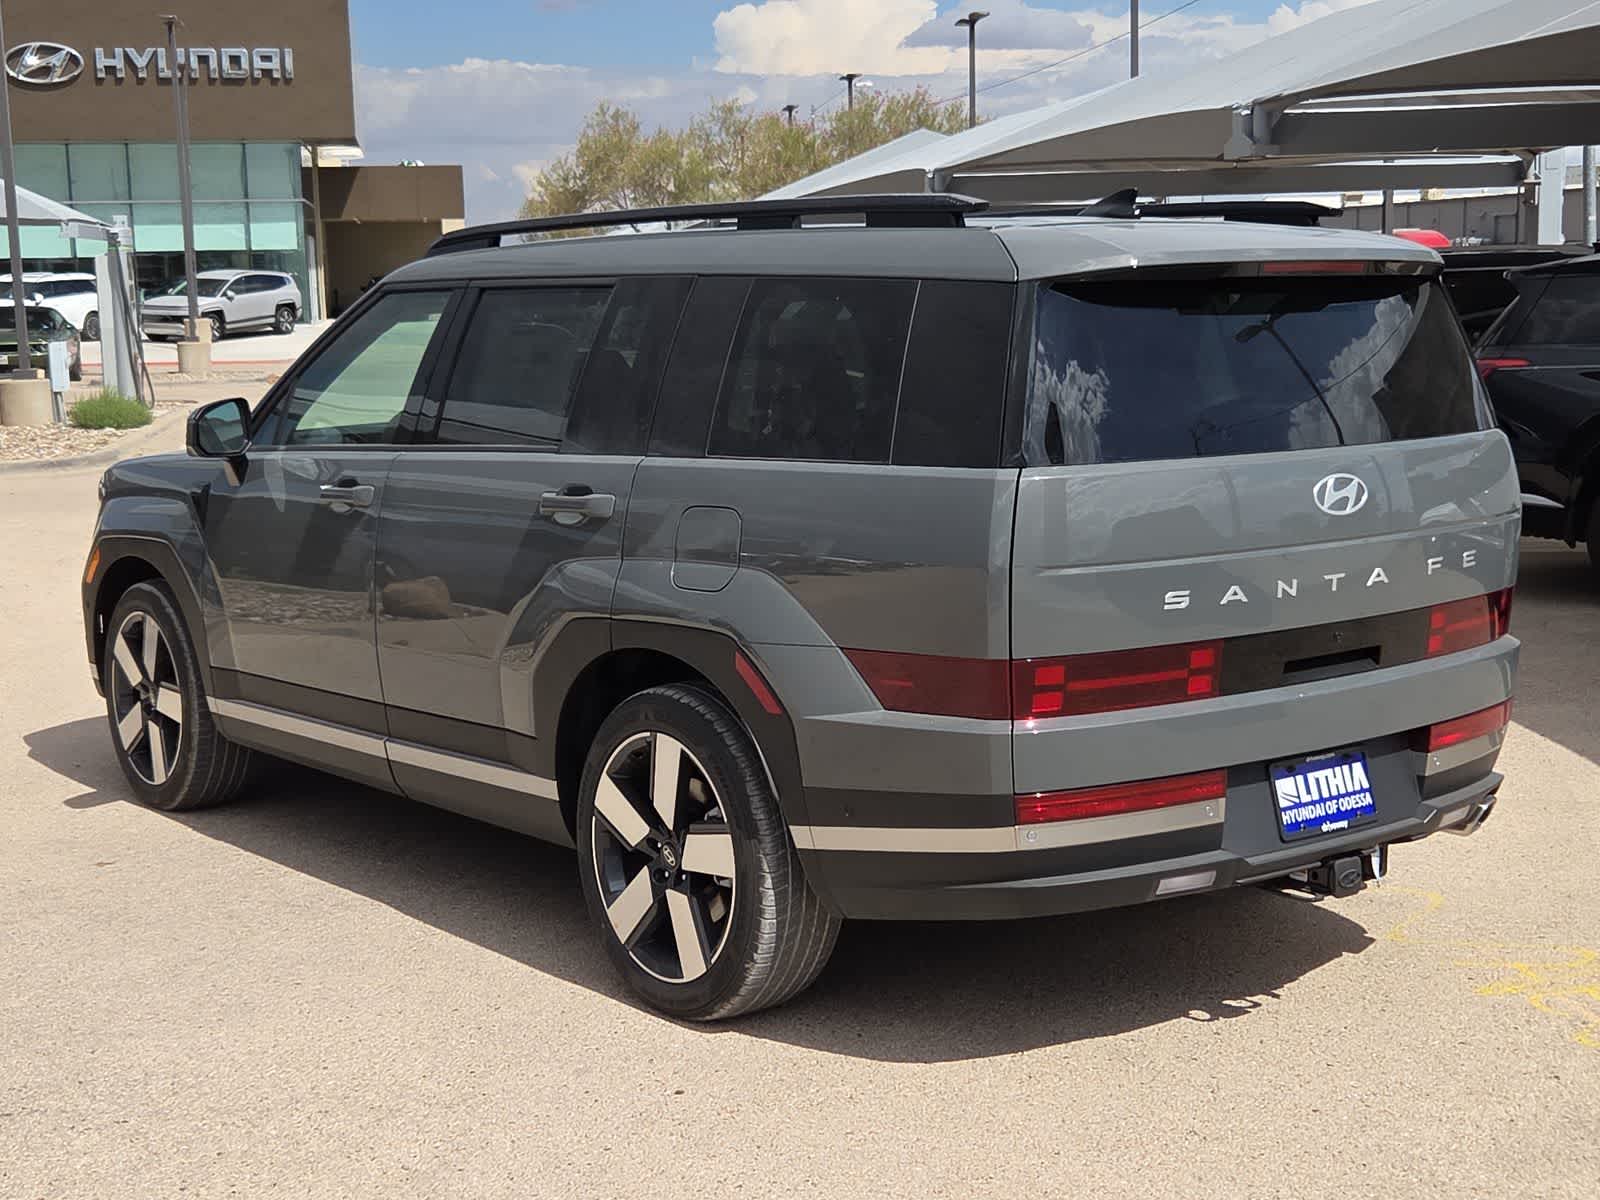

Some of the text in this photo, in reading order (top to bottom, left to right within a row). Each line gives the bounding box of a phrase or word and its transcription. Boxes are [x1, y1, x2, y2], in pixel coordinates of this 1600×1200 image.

[95, 47, 294, 79] HYUNDAI
[1163, 550, 1477, 610] SANTA FE
[1296, 762, 1370, 803] LITHIA
[1281, 792, 1373, 825] HYUNDAI OF ODESSA
